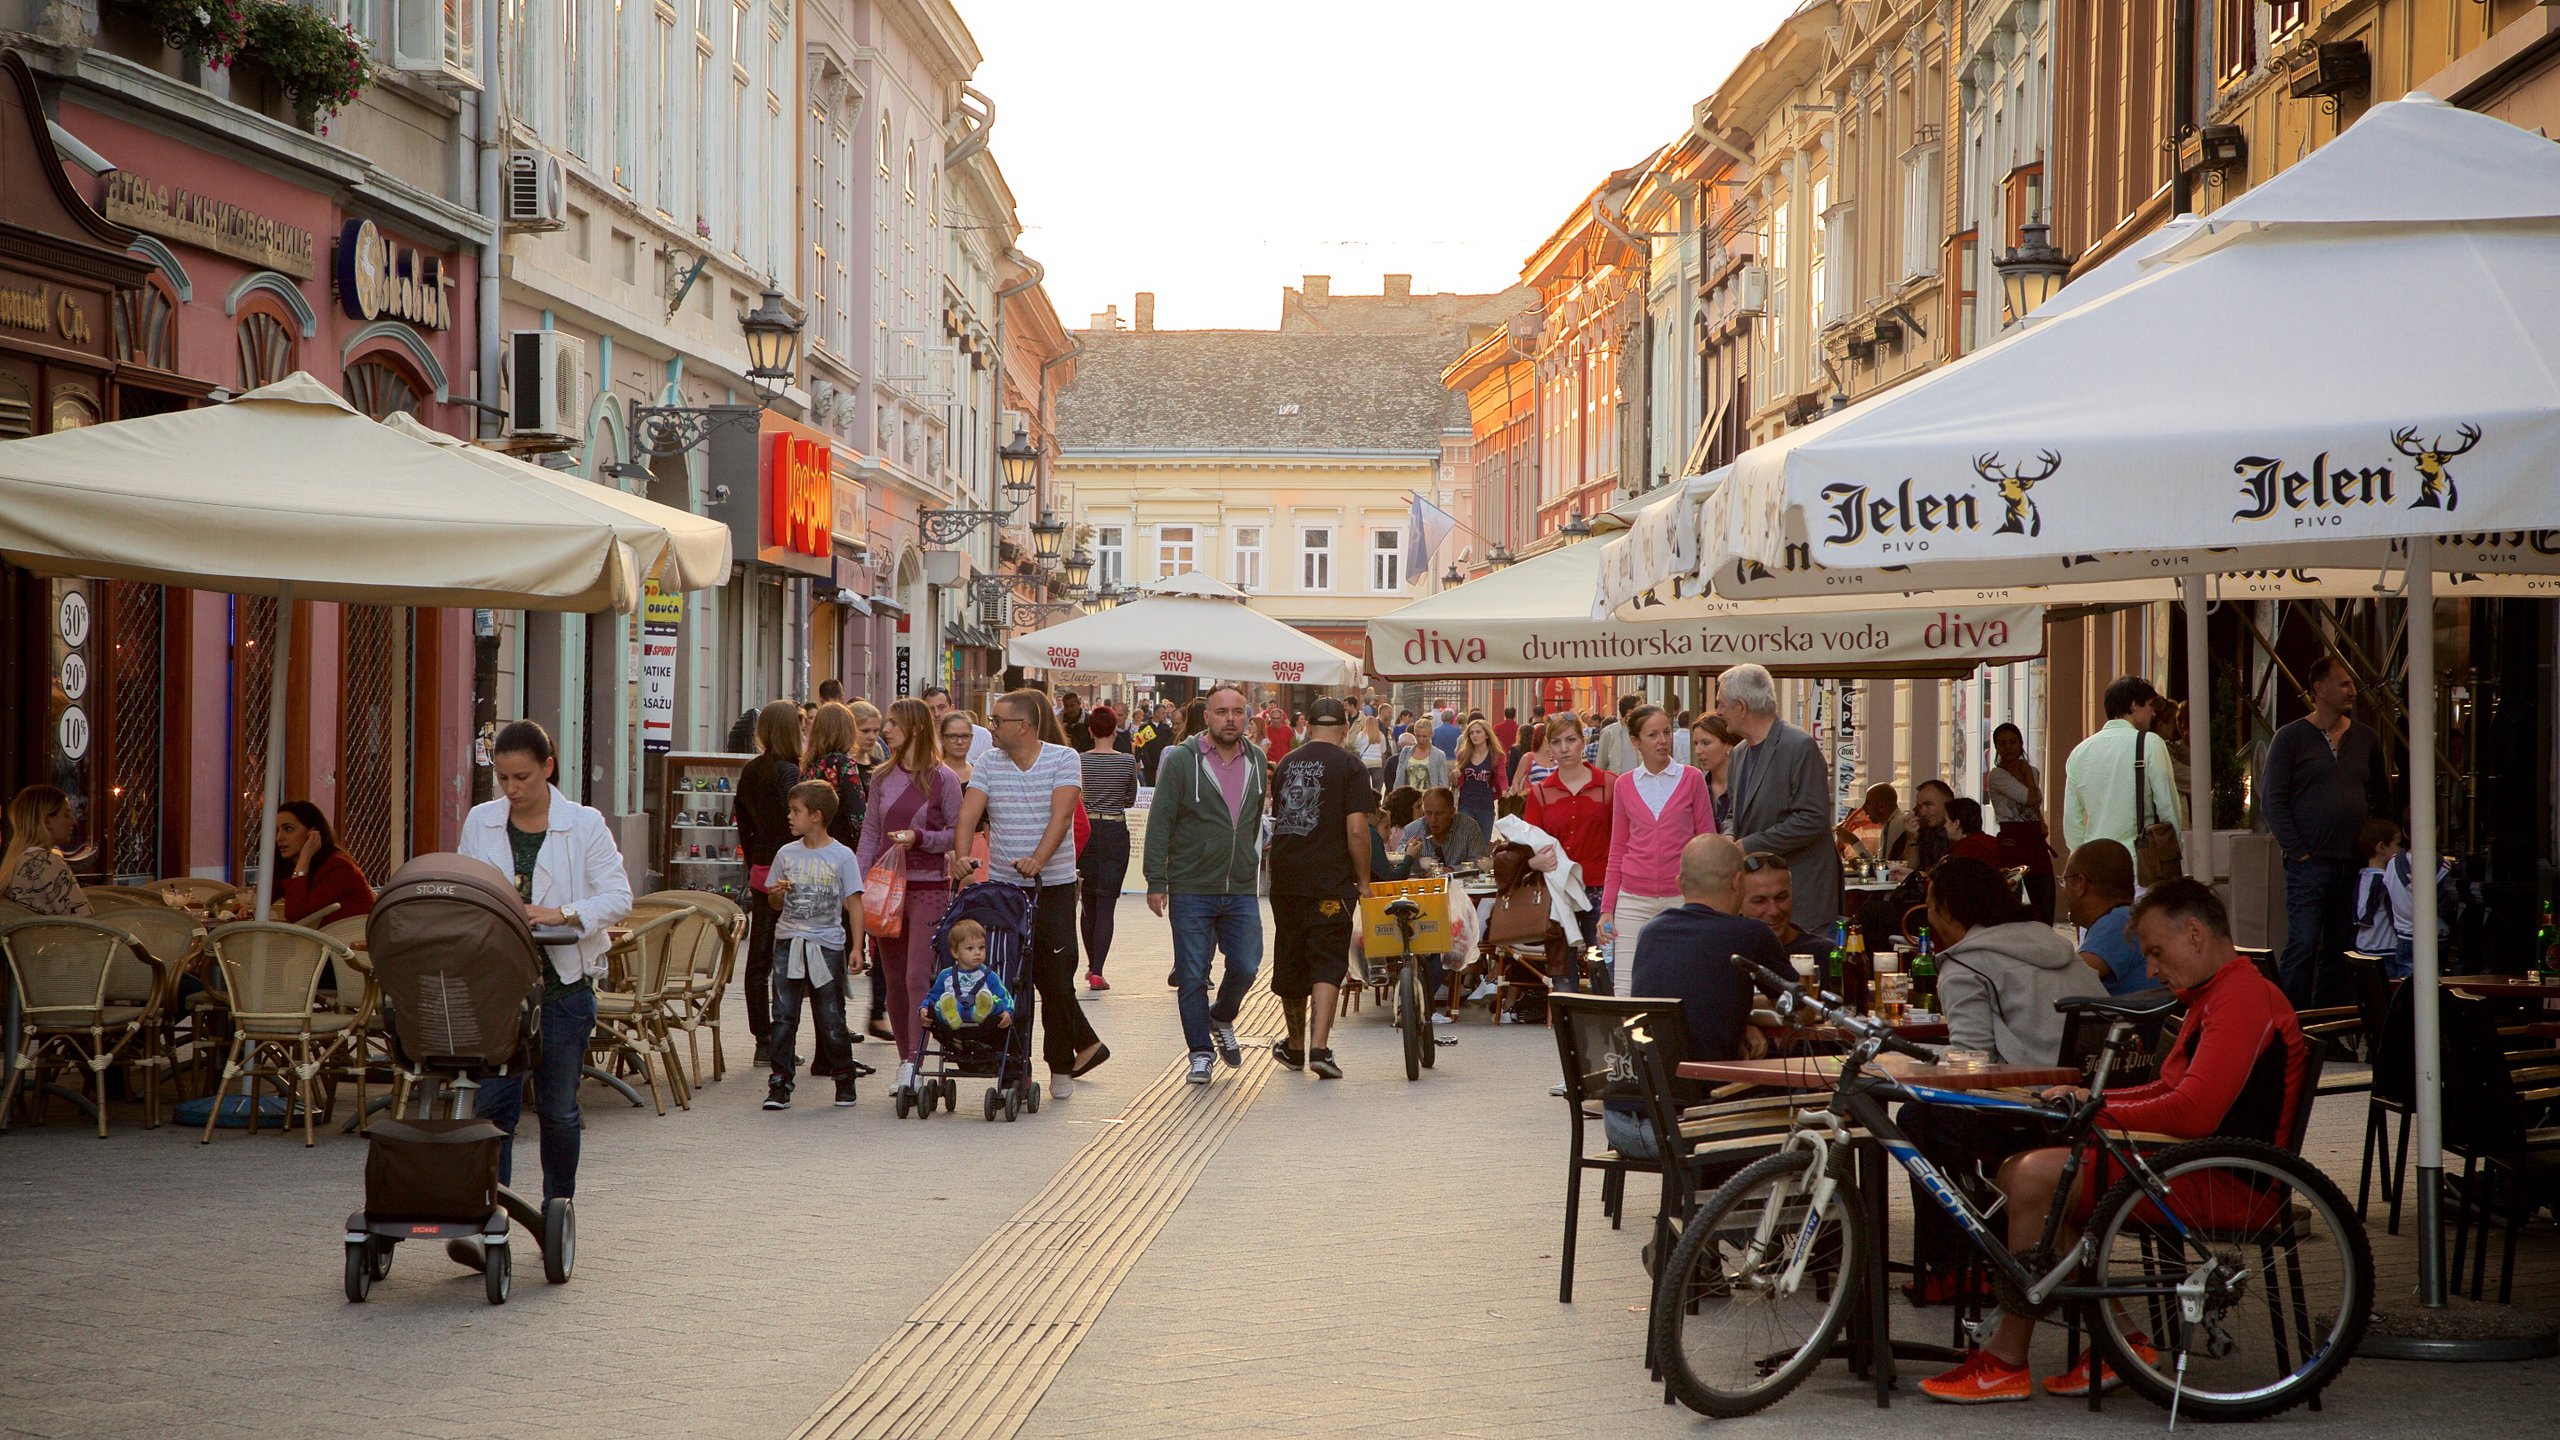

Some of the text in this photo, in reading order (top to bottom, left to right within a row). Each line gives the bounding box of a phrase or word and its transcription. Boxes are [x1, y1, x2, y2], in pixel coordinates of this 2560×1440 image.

[176, 187, 187, 227] и
[2232, 451, 2397, 525] Jelen
[1820, 477, 1982, 548] Jelen
[2294, 515, 2342, 528] PIVO
[1882, 541, 1929, 553] PIVO
[64, 603, 86, 637] 30%
[1924, 612, 2009, 650] diva
[1404, 623, 1889, 666] diva durmitorska izvorska voda
[65, 663, 85, 691] 20%
[900, 661, 908, 694] SAKO
[1050, 658, 1076, 668] viva
[1162, 661, 1189, 673] viva
[1275, 671, 1301, 682] viva
[643, 695, 672, 709] ASAŽU
[651, 682, 658, 693] U
[65, 718, 87, 749] 10%
[416, 884, 455, 895] STOKKE
[1907, 1155, 1985, 1233] SCOTT
